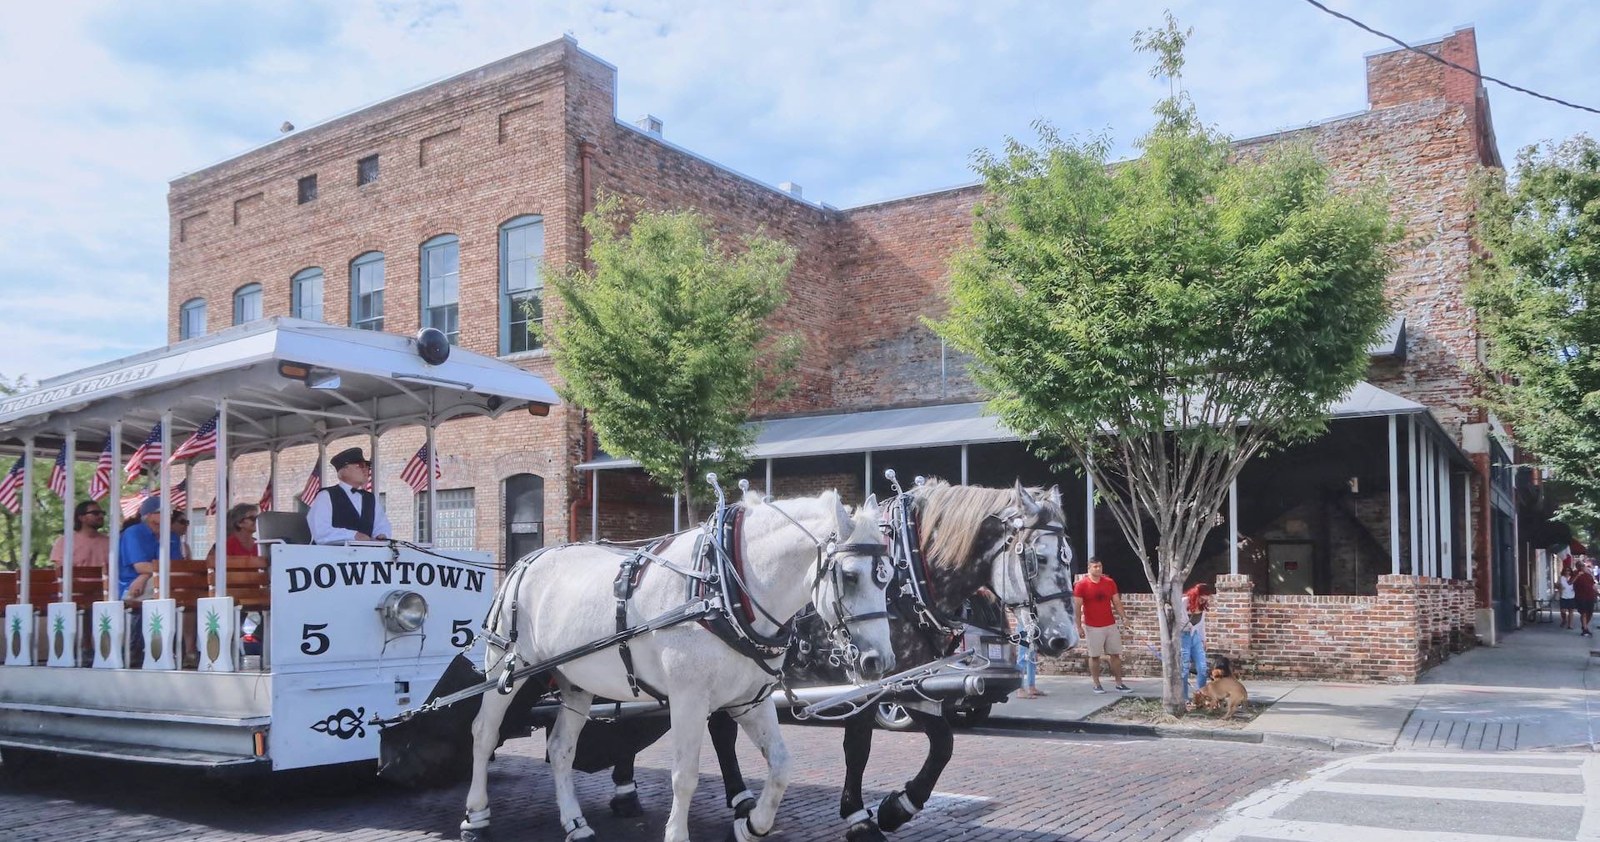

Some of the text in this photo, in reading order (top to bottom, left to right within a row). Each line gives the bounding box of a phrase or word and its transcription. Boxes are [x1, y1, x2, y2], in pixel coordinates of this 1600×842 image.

[76, 363, 157, 393] TROLLEY
[285, 561, 486, 593] DOWNTOWN
[300, 623, 330, 655] 5
[450, 619, 474, 648] 5
